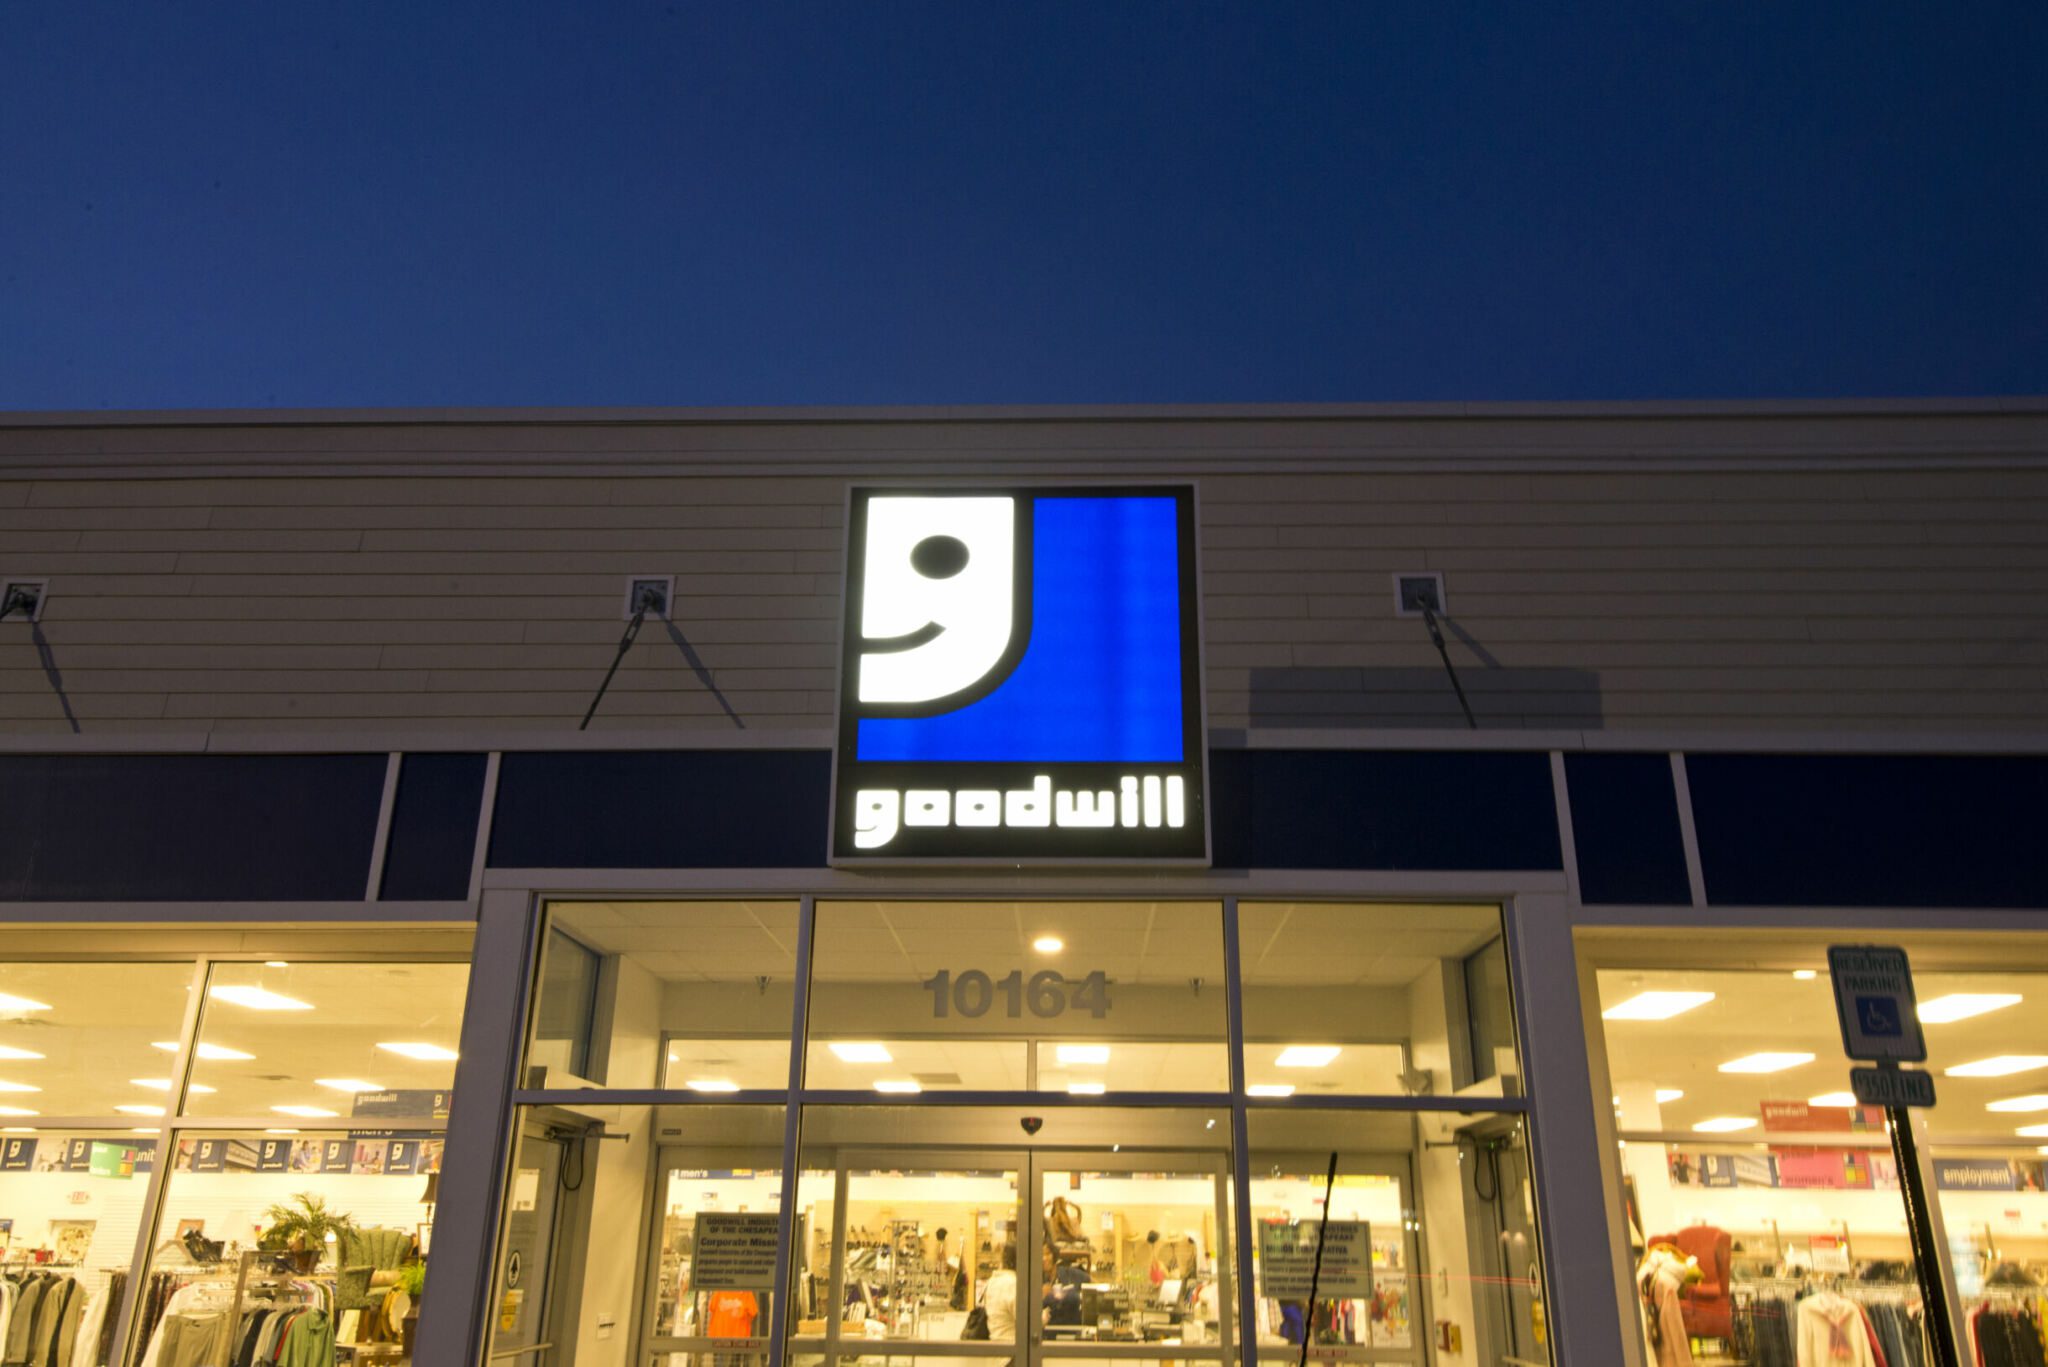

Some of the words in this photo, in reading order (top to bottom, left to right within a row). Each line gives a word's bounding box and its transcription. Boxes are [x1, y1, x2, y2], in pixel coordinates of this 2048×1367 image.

[854, 775, 1185, 849] goodwill
[1836, 956, 1903, 971] RESERVED
[1844, 976, 1900, 990] PARKING
[923, 969, 1112, 1019] 10164
[358, 1093, 398, 1105] goodwill
[1765, 1105, 1808, 1119] goodwill
[680, 1169, 708, 1178] men's
[1943, 1166, 2011, 1187] employment
[701, 1237, 747, 1248] Corporate
